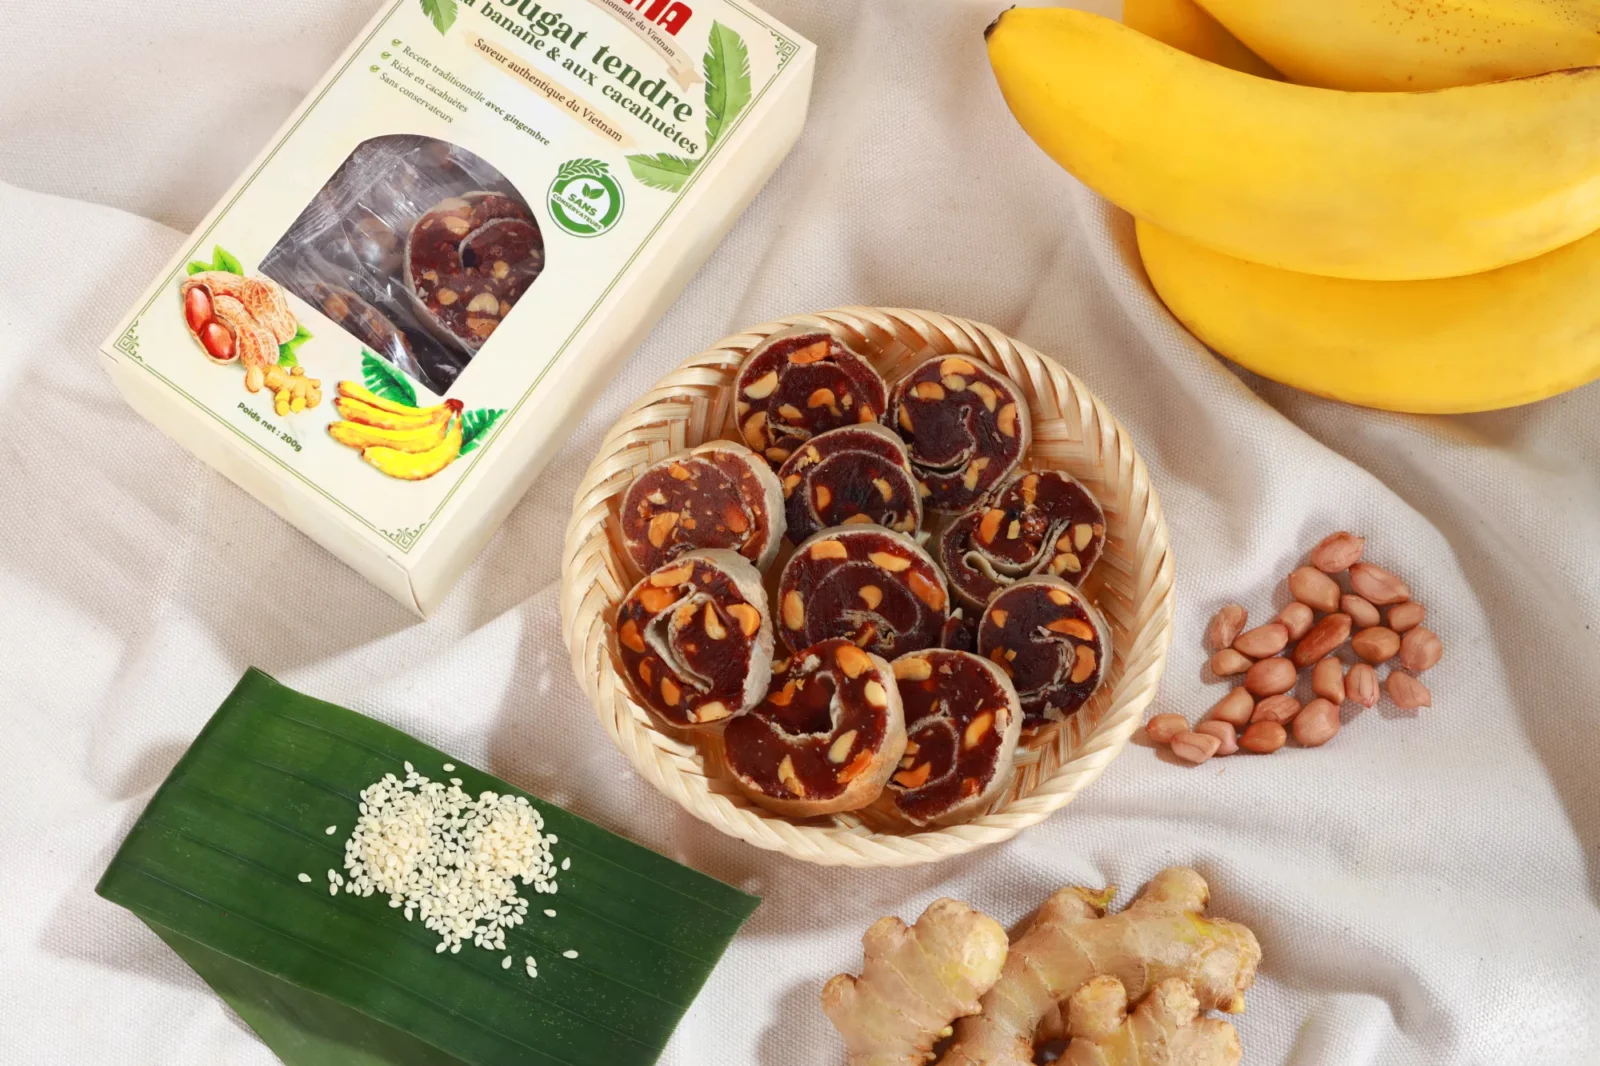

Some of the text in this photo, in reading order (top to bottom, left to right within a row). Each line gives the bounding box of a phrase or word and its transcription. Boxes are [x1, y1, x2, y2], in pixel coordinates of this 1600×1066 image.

[635, 20, 647, 31] du
[647, 27, 675, 57] Vietnam
[379, 72, 453, 124] Sans conservateurs
[390, 59, 468, 113] Riche en cacahuètes
[402, 45, 550, 146] Recette traditionnelle avec gingembre
[474, 38, 623, 142] Saveur authentique du Vietnam
[480, 1, 545, 50] banane
[546, 47, 560, 61] &
[562, 58, 598, 86] aux
[602, 84, 698, 154] cacahuètes
[592, 45, 692, 122] tendre
[552, 193, 602, 229] CONSERVATEURS
[568, 193, 597, 216] SANS
[237, 402, 261, 422] Poids
[260, 420, 276, 433] net
[280, 433, 302, 453] 200g
